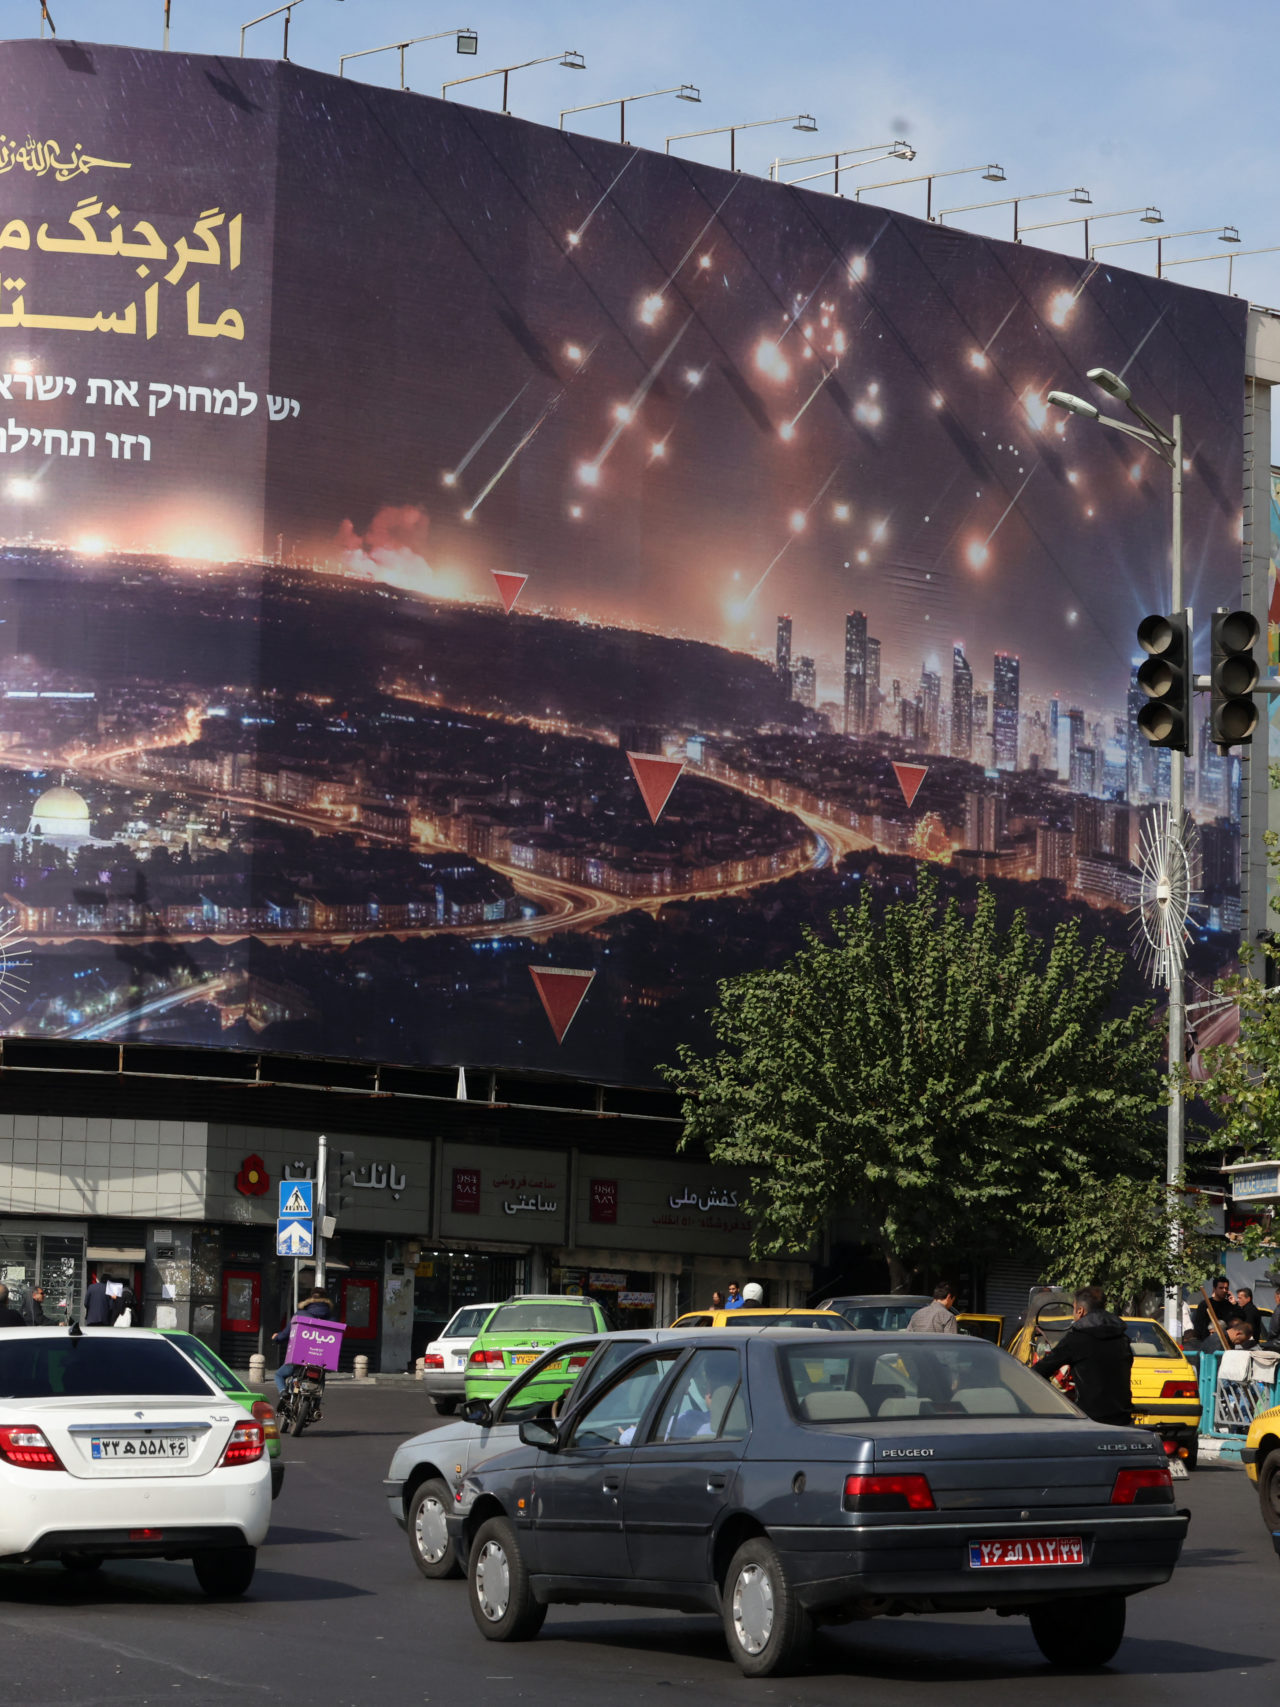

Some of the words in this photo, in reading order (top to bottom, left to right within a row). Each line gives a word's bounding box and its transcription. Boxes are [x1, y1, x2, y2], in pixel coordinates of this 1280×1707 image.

[36, 195, 168, 279] جنگ
[164, 206, 242, 285] اگر
[186, 281, 245, 341] ما
[86, 376, 141, 408] את
[148, 382, 259, 416] למחוק
[268, 393, 301, 422] יש
[105, 429, 152, 461] וזו
[1235, 1175, 1257, 1194] POLICE
[504, 1193, 557, 1215] ساعتی
[669, 1186, 697, 1209] ملی
[698, 1184, 738, 1212] کفش
[301, 1330, 336, 1345] میاره
[102, 1440, 120, 1456] ۳۳
[139, 1439, 167, 1455] ۵۵۸
[169, 1441, 186, 1456] ۴۶
[882, 1447, 935, 1458] PEUGEOT
[1097, 1443, 1128, 1452] 405
[1129, 1442, 1154, 1450] GLX
[981, 1542, 1003, 1564] ۲۶
[1004, 1543, 1023, 1562] الف
[1025, 1541, 1057, 1562] ۱۱۲
[1059, 1543, 1081, 1562] ۳۳
